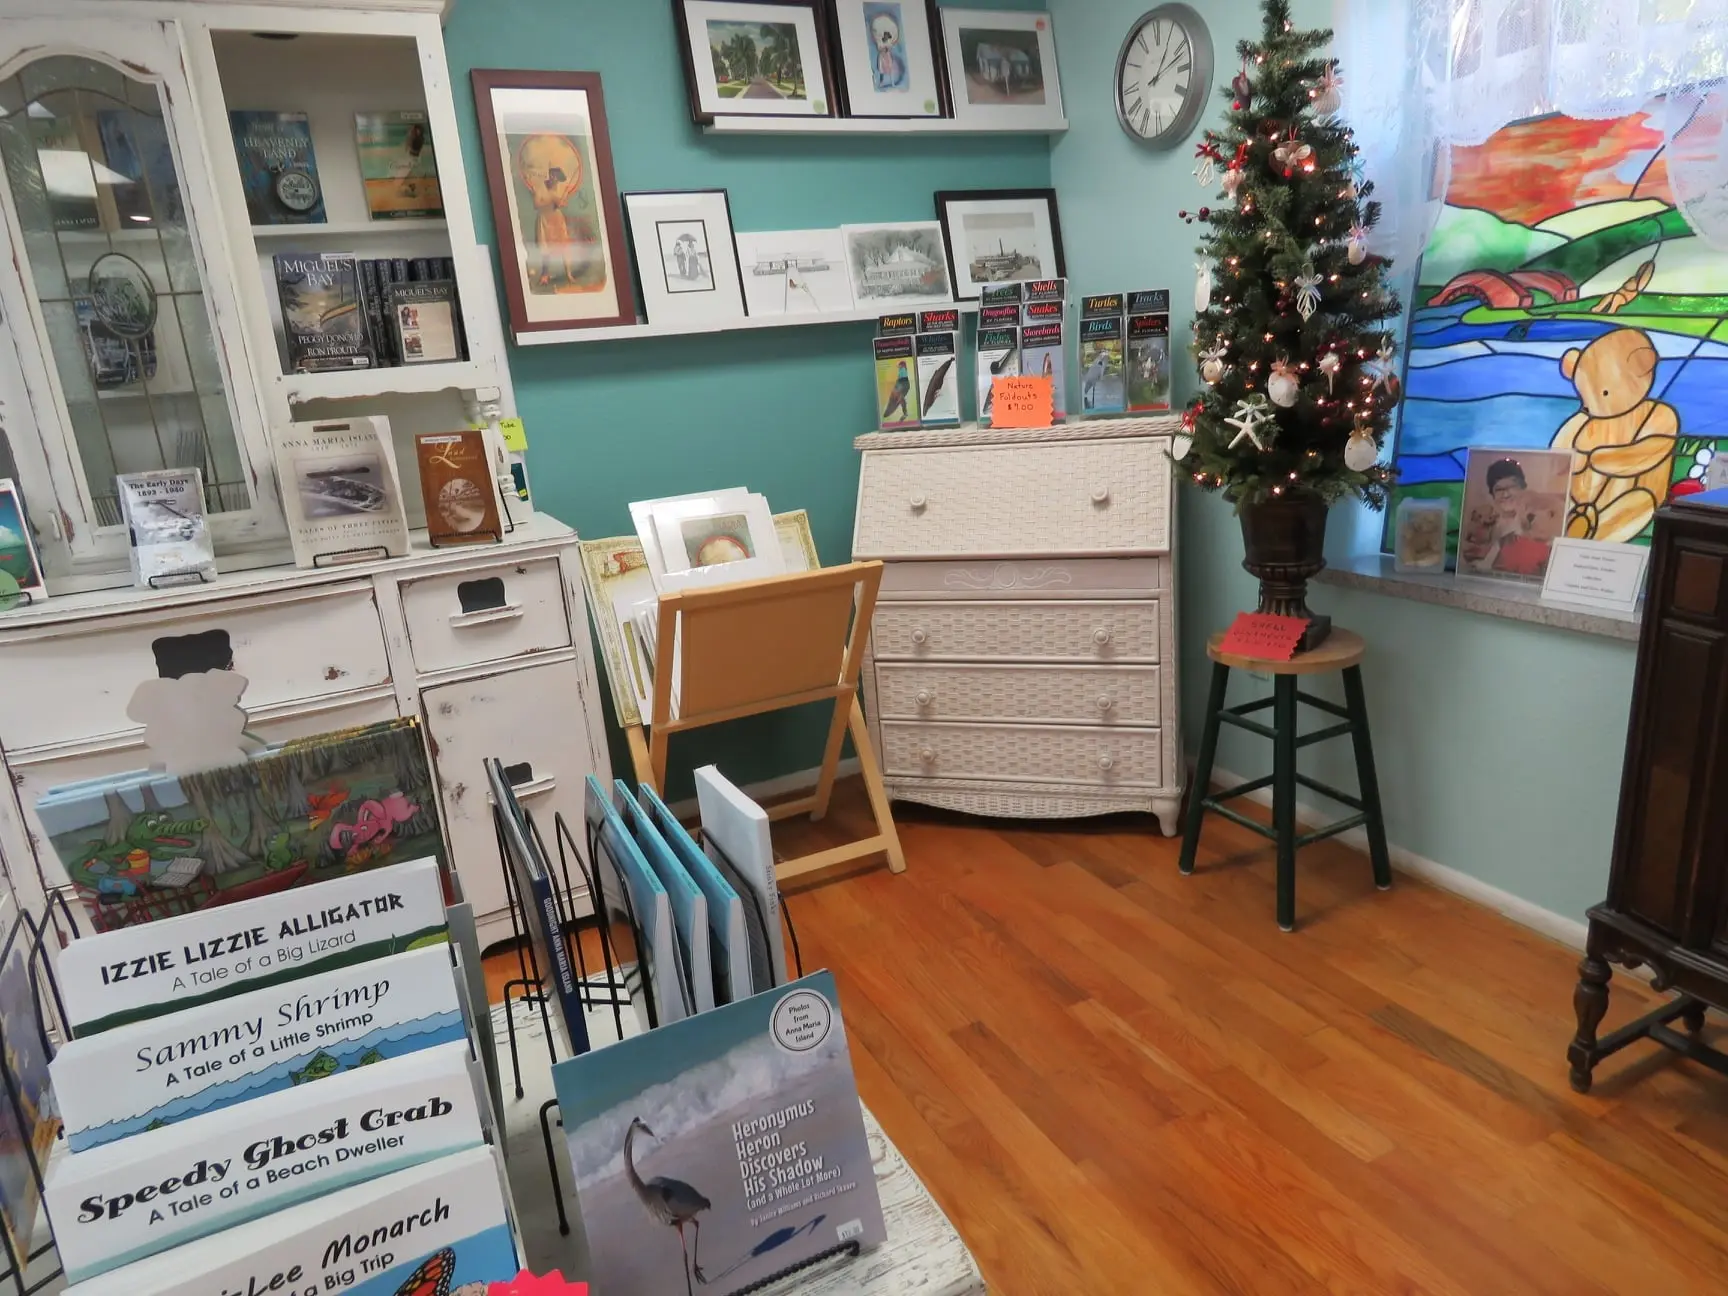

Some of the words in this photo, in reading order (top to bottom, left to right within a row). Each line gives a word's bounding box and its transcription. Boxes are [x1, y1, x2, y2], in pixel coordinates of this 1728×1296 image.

[262, 148, 297, 160] LAND
[284, 259, 352, 273] MIGUEL'S
[306, 273, 334, 287] BAY
[1032, 280, 1057, 292] Shells
[394, 287, 433, 297] MIGUEL'S
[433, 286, 449, 296] BAY
[1134, 291, 1164, 303] Tracks
[1029, 303, 1058, 313] Snakes
[1088, 296, 1118, 309] Turtles
[923, 311, 956, 322] Sharks
[983, 306, 1017, 317] Dragonflies
[883, 316, 913, 328] Raptors
[1088, 319, 1112, 331] Birds
[1023, 325, 1060, 337] Shorebirds
[307, 346, 325, 356] RON
[1007, 381, 1034, 390] Nature
[999, 391, 1038, 401] Foldouts
[312, 436, 345, 447] MARIA
[147, 480, 167, 489] Early
[169, 478, 189, 487] Days
[543, 897, 559, 935] GOODNIGHT
[101, 951, 175, 985] IZZIE
[184, 927, 269, 965] LIZZIE
[279, 893, 404, 939] ALLIGATOR
[552, 934, 564, 953] ANNA
[172, 976, 186, 992] A
[190, 967, 229, 986] Tale
[235, 957, 252, 974] of
[258, 954, 271, 967] a
[277, 945, 304, 962] Big
[308, 930, 356, 954] Lizard
[556, 951, 569, 975] MARIA
[561, 970, 573, 994] ISLAND
[788, 1003, 810, 1014] Photos
[136, 1016, 263, 1072] Sammy
[278, 979, 390, 1028] Shrimp
[794, 1014, 809, 1024] from
[785, 1026, 802, 1036] Anna
[803, 1021, 821, 1032] Maria
[795, 1031, 814, 1043] Island
[166, 1072, 180, 1088] A
[184, 1059, 223, 1081] Tale
[229, 1050, 246, 1065] of
[252, 1046, 265, 1058] a
[270, 1031, 310, 1053] Little
[316, 1012, 373, 1038] Shrimp
[732, 1099, 816, 1141] Heronymus
[736, 1131, 781, 1160] Heron
[77, 1158, 231, 1223] Speedy
[243, 1117, 350, 1171] Ghost
[360, 1096, 453, 1132] Crab
[740, 1141, 807, 1180] Discovers
[149, 1209, 164, 1225] A
[168, 1192, 213, 1217] Tale
[219, 1180, 239, 1199] of
[246, 1177, 260, 1190] a
[266, 1154, 330, 1184] Beach
[336, 1134, 405, 1162] Dweller
[744, 1174, 766, 1198] His
[769, 1155, 824, 1188] Shadow
[746, 1194, 767, 1211] (and
[768, 1192, 774, 1202] a
[775, 1183, 800, 1199] Whole
[801, 1175, 814, 1189] Lot
[817, 1165, 841, 1182] More)
[221, 1264, 304, 1296] -Lee
[321, 1197, 450, 1269] Monarch
[304, 1283, 318, 1296] a
[324, 1267, 356, 1289] Big
[360, 1250, 395, 1274] Trip
